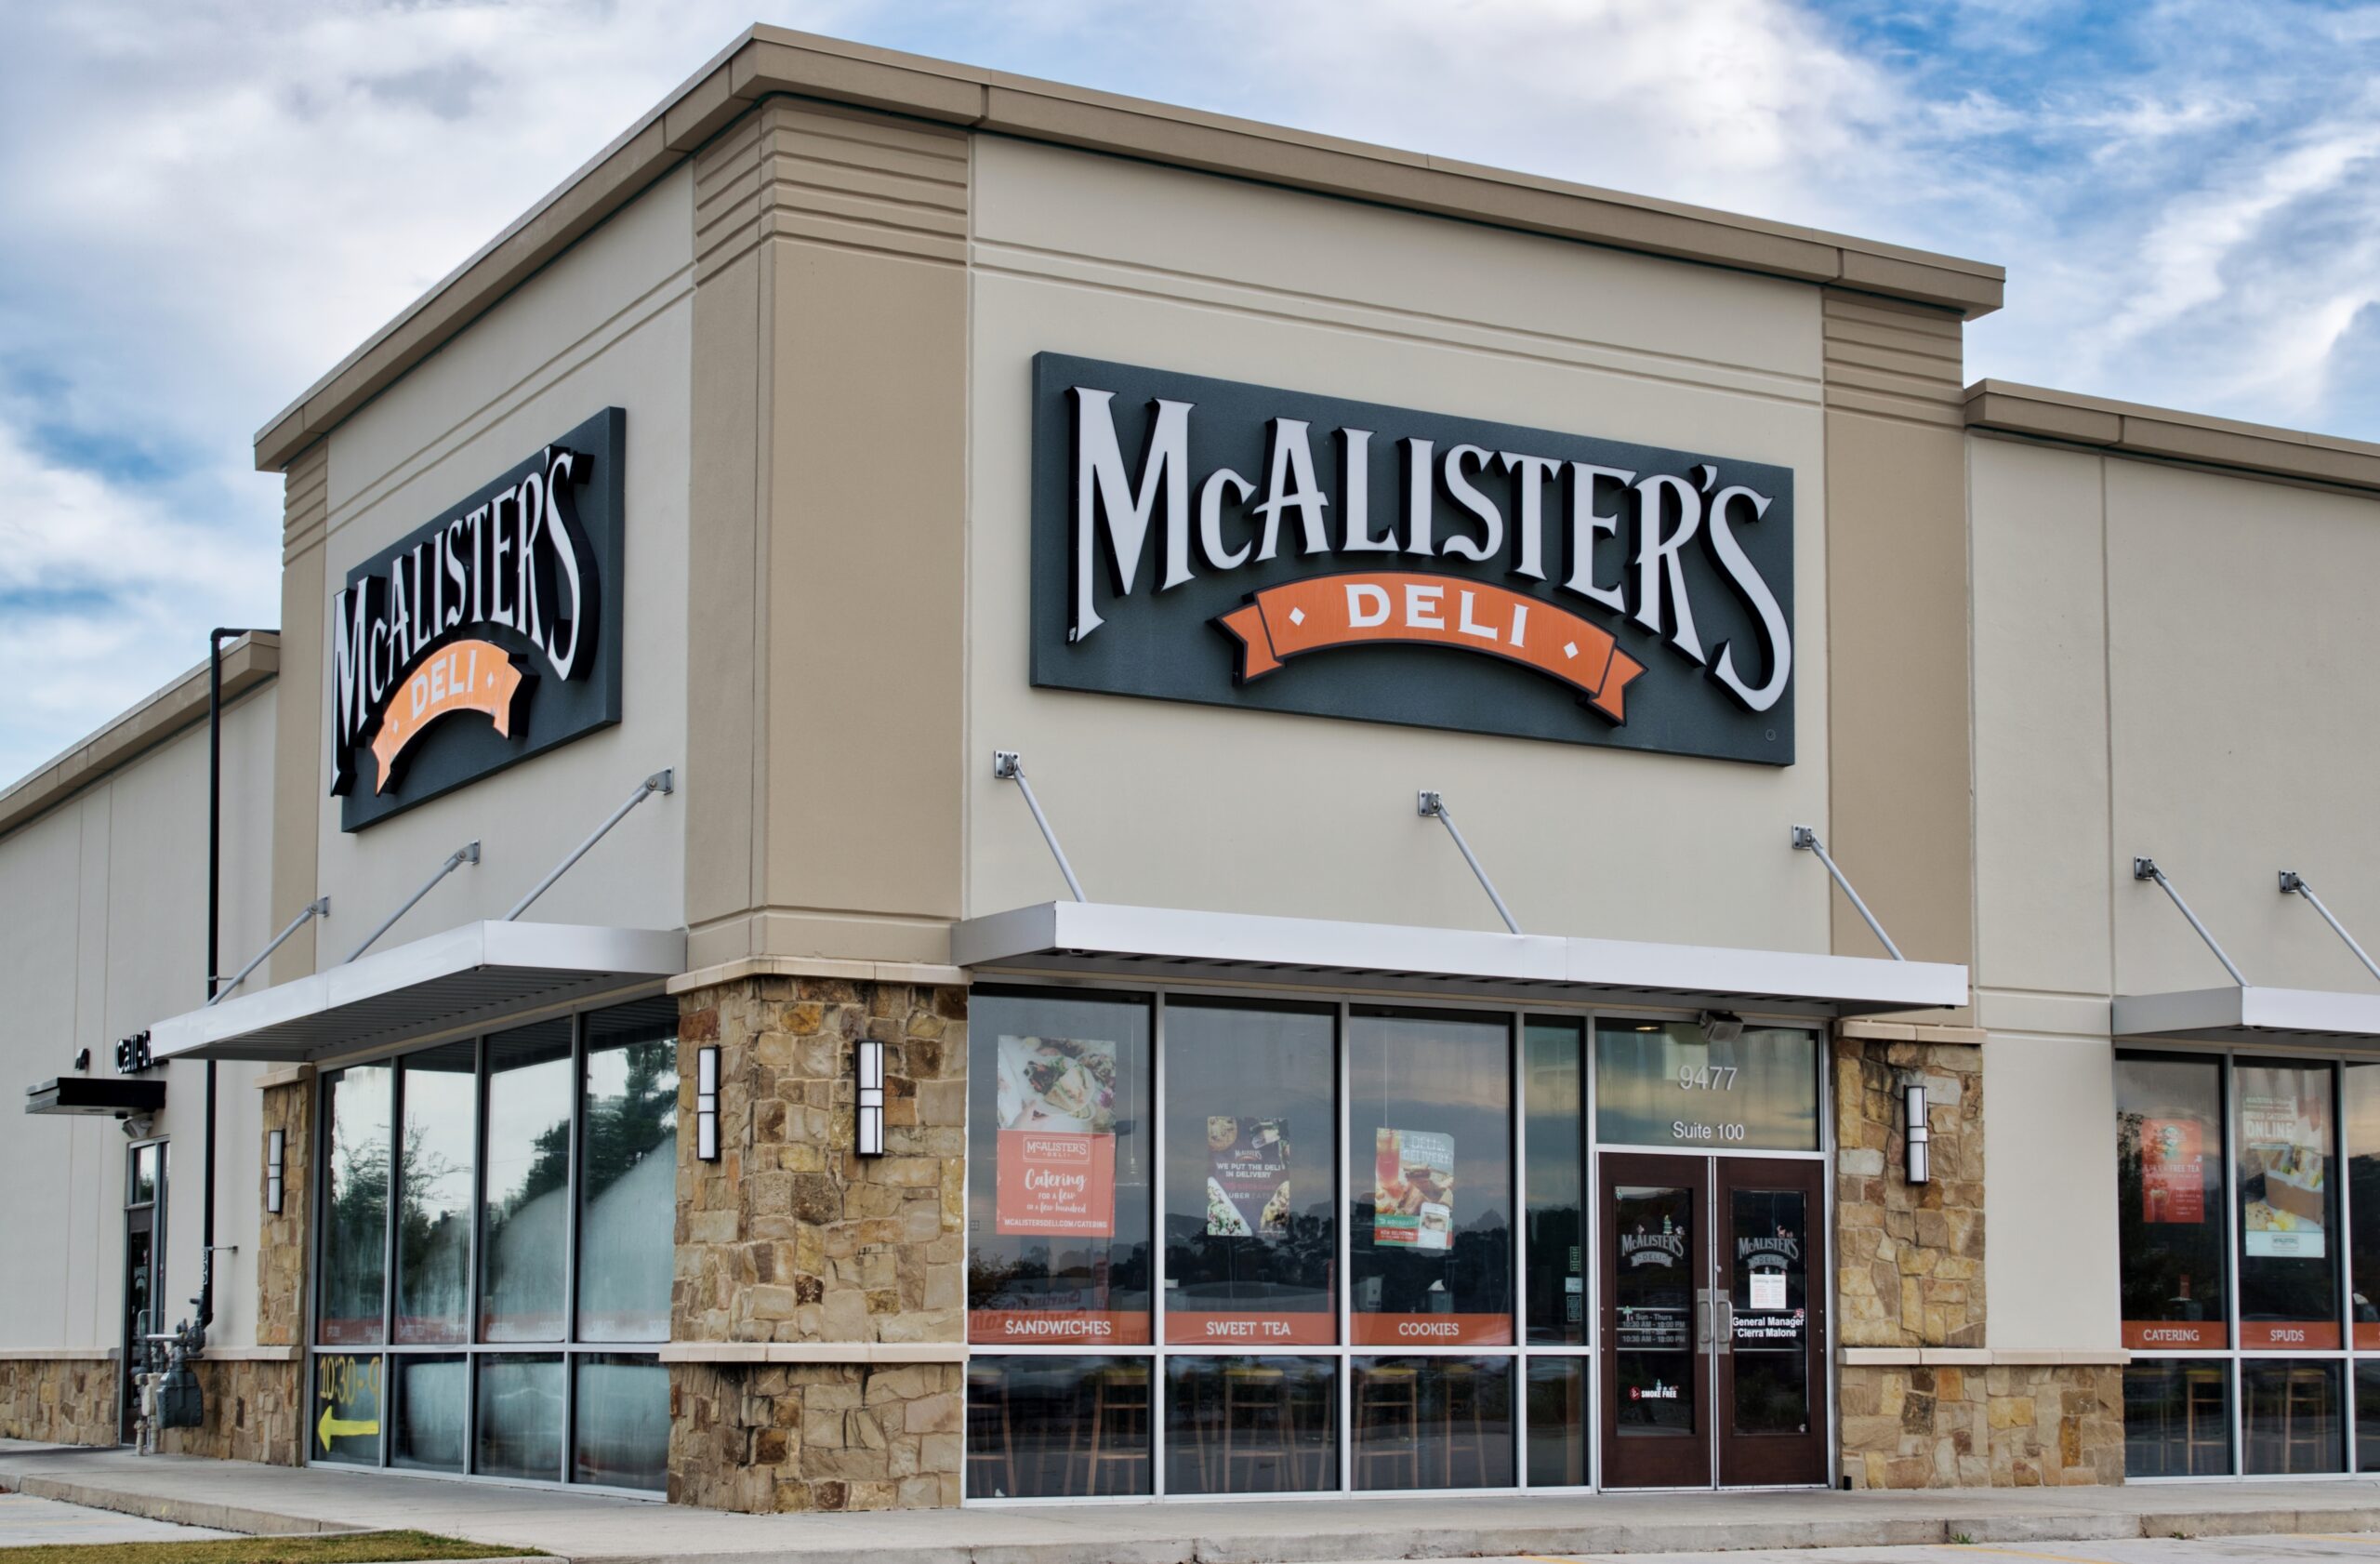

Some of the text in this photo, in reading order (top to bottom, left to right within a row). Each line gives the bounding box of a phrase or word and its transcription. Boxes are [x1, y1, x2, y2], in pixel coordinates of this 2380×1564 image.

[1345, 582, 1527, 649] DELI
[410, 649, 476, 716] DELI
[115, 1029, 153, 1074] Call-i
[1679, 1065, 1739, 1091] 9477
[1673, 1120, 1745, 1141] Suite 100
[2245, 1120, 2293, 1138] ONLINE
[1025, 1168, 1087, 1191] Catering
[1059, 1189, 1076, 1203] few
[1055, 1202, 1087, 1213] hundred
[1005, 1319, 1112, 1335] SANDWICHES
[1206, 1321, 1290, 1335] SWEET TEA
[1398, 1322, 1459, 1336] COOKIES
[1733, 1318, 1805, 1328] General Manager
[1766, 1329, 1797, 1338] Malone
[2143, 1329, 2199, 1341] CATERING
[2270, 1330, 2304, 1342] SPUDS
[320, 1356, 357, 1406] 10:30
[368, 1356, 380, 1417] 9
